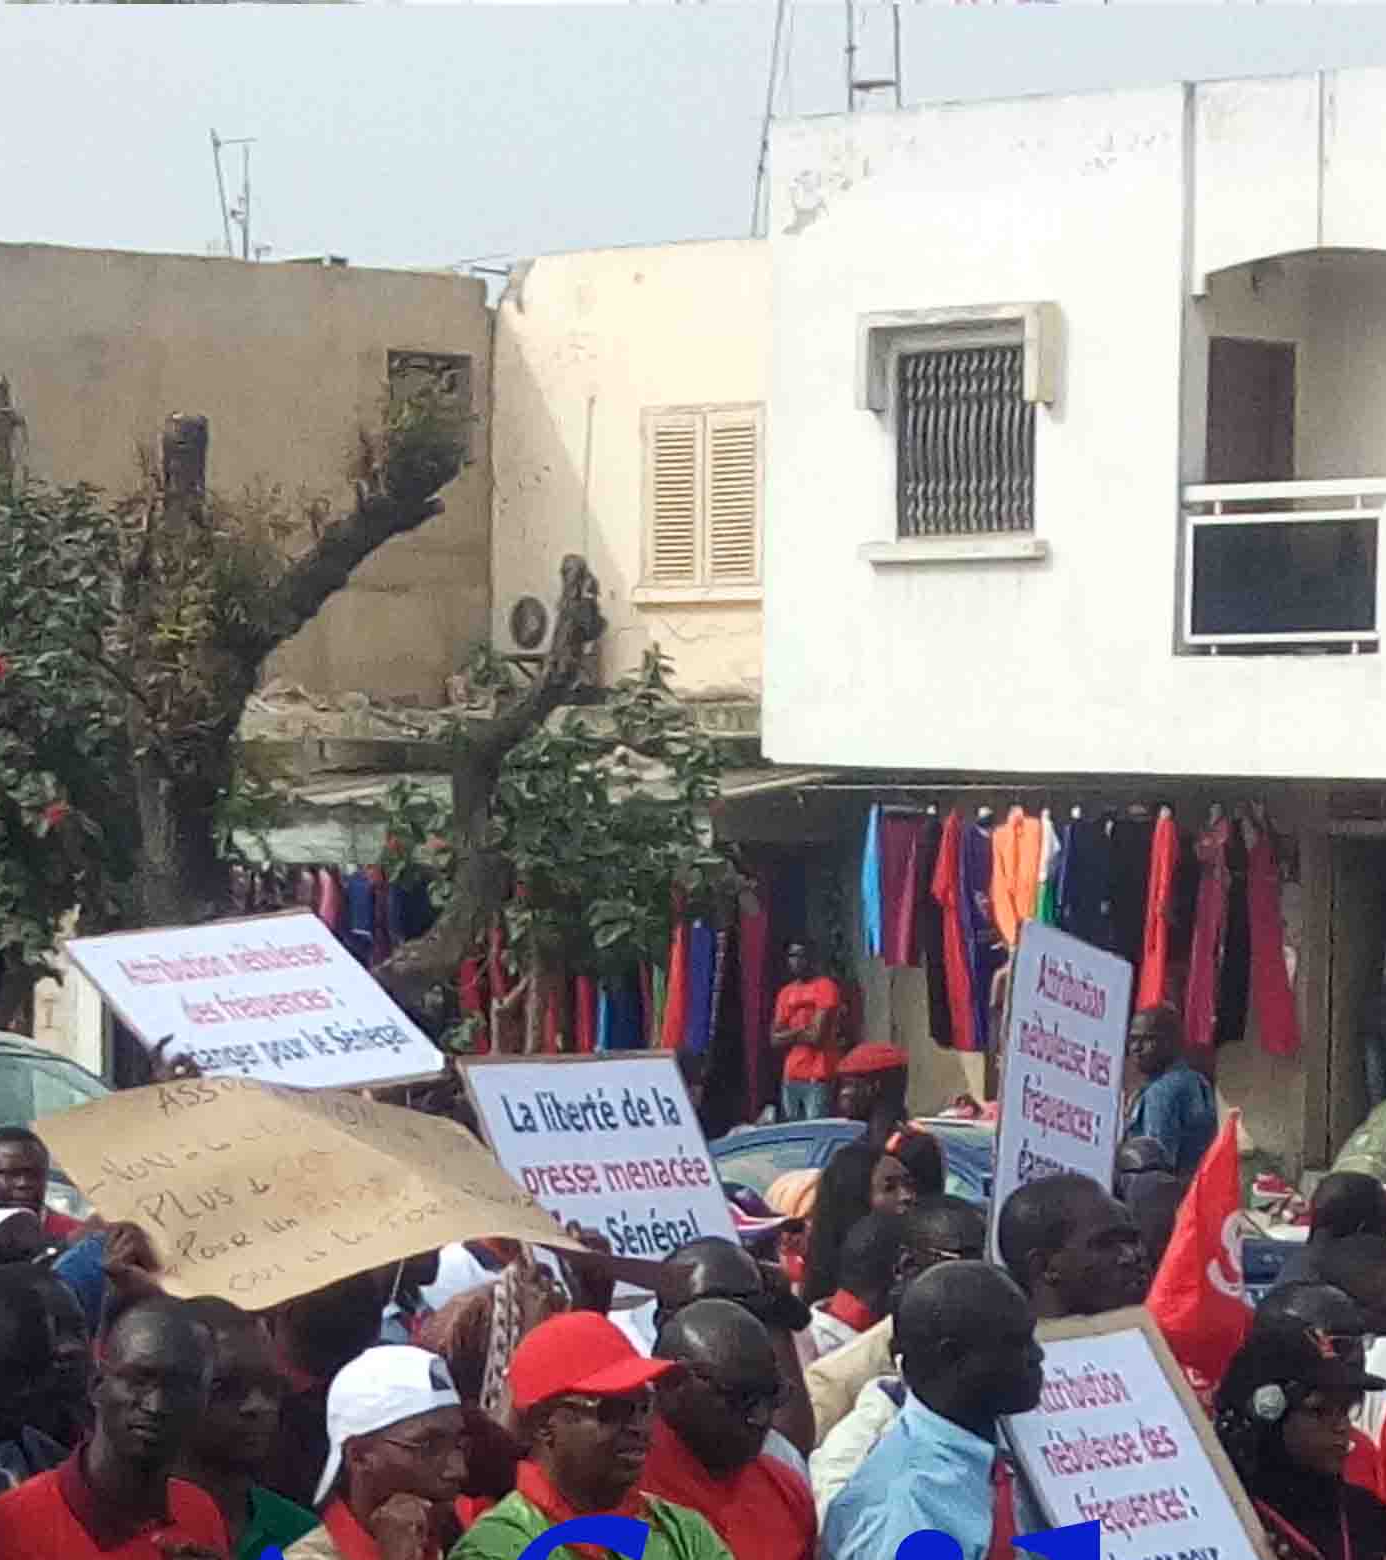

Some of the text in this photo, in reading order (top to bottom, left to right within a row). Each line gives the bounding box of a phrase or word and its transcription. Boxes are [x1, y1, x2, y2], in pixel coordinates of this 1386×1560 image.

[501, 1086, 682, 1133] La liberté de la
[520, 1144, 711, 1199] presse menacée
